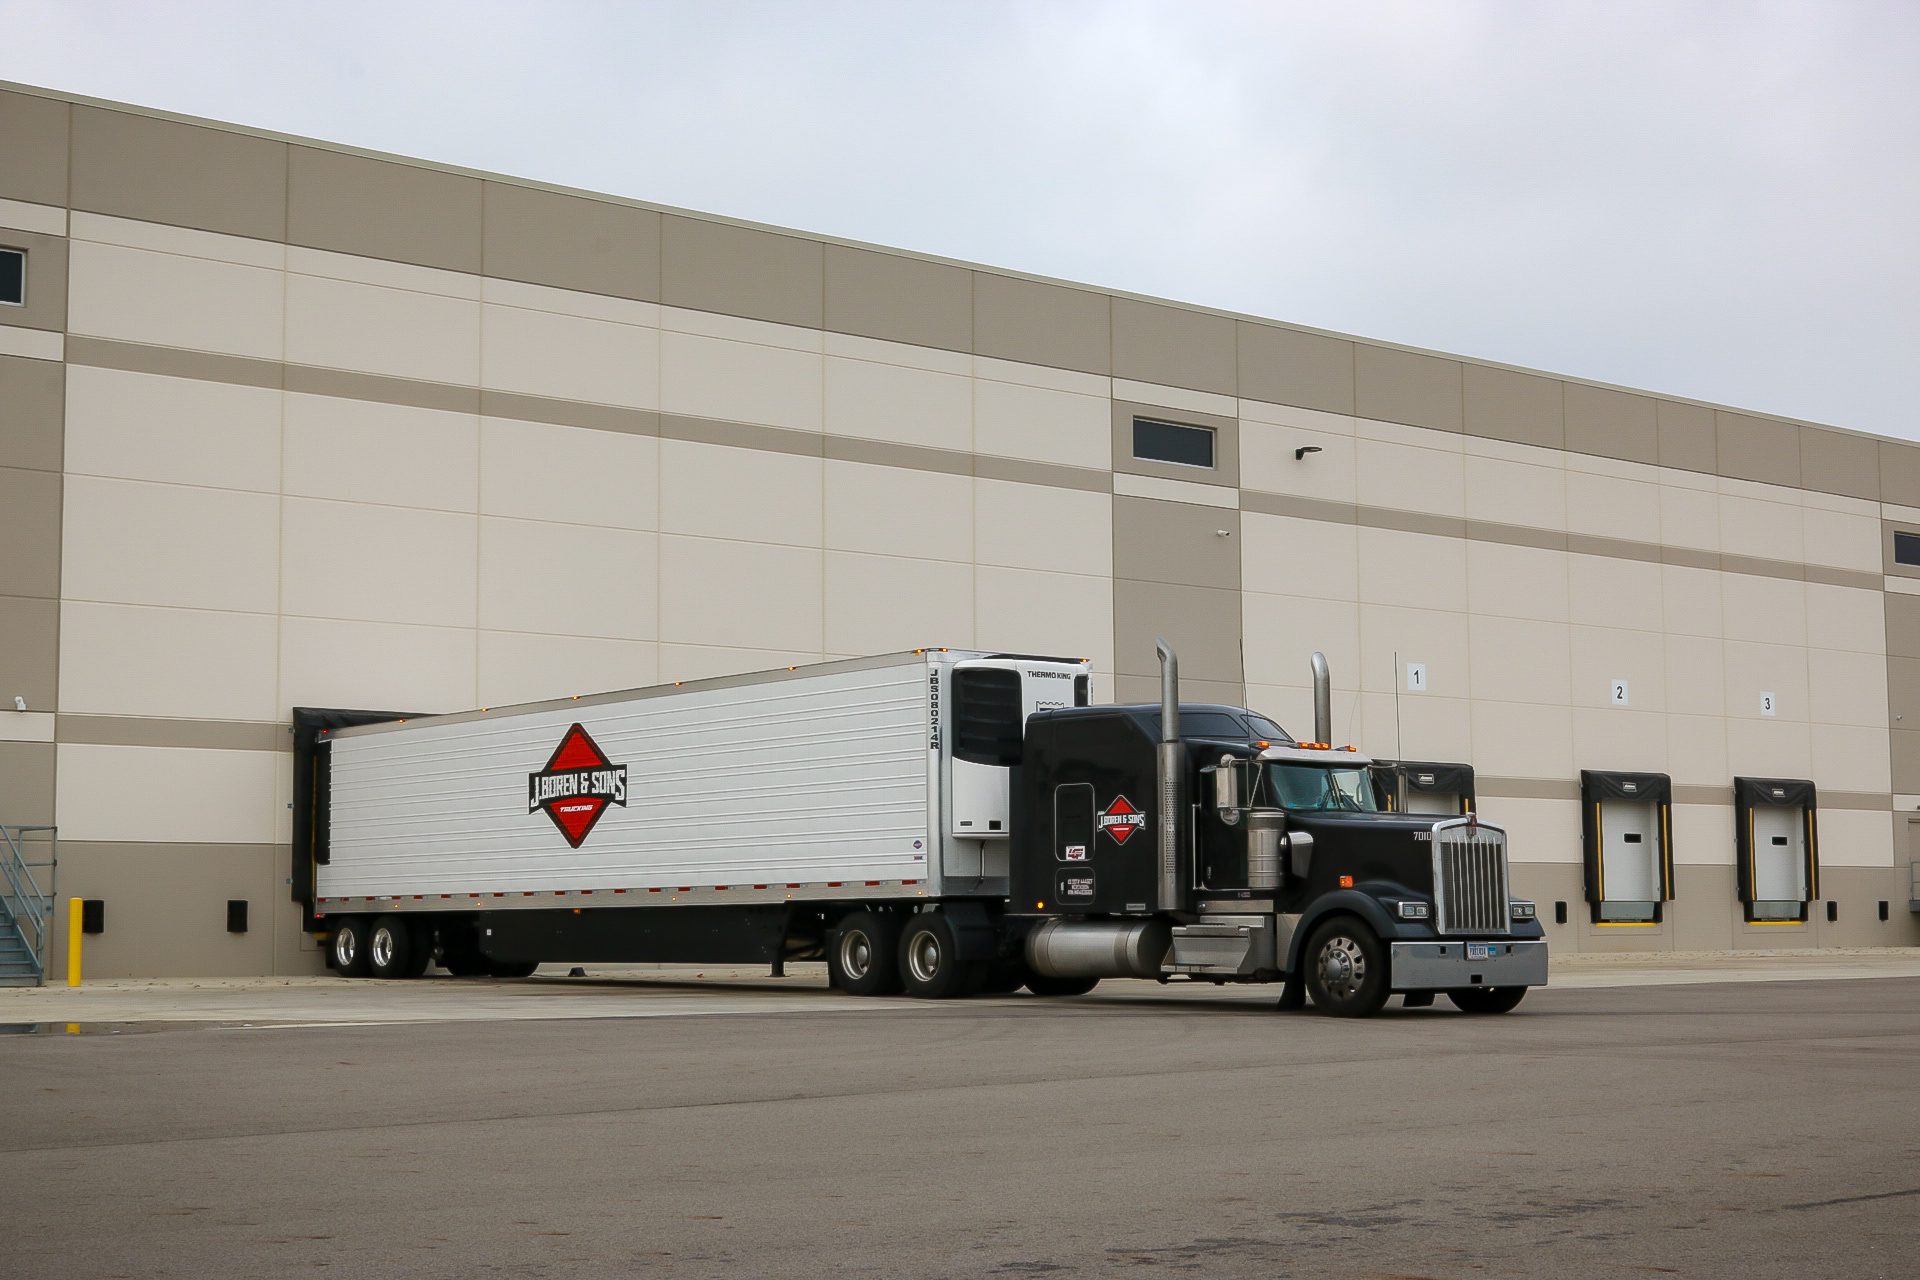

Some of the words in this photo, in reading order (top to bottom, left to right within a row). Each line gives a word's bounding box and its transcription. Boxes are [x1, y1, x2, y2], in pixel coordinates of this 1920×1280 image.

[1027, 670, 1056, 679] THERMO
[1057, 672, 1071, 680] KING
[1413, 669, 1420, 685] 1
[1616, 685, 1623, 700] 2
[930, 669, 939, 749] JBS080214R
[1764, 697, 1771, 713] 3
[580, 772, 589, 794] &
[591, 769, 626, 801] SONS
[1128, 813, 1145, 827] SONS
[1413, 831, 1432, 841] 7010
